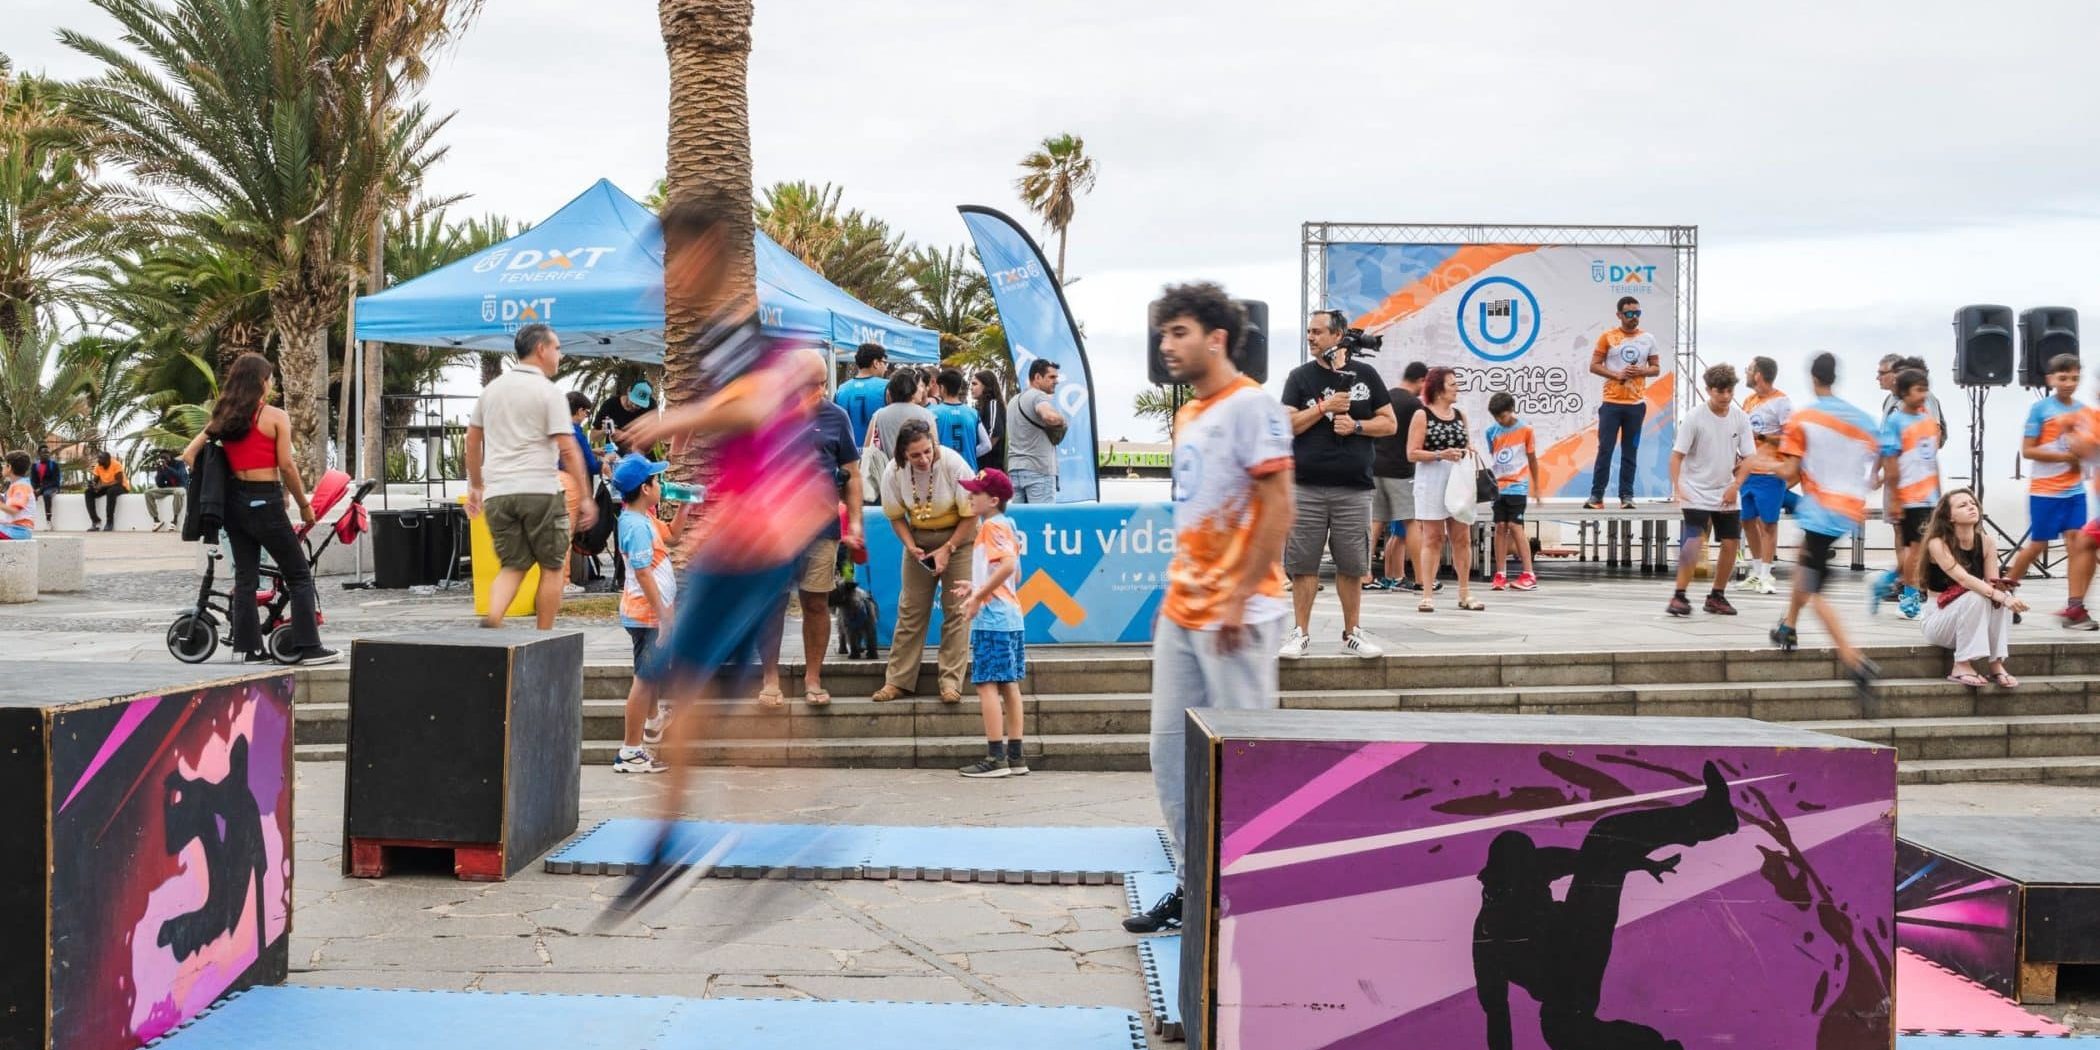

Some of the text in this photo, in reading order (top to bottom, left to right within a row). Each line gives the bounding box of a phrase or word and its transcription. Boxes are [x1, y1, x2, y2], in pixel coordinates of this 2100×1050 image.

[506, 247, 616, 270] DXT
[500, 270, 588, 283] TENERIFE
[1609, 265, 1656, 283] DXT
[1609, 284, 1653, 294] TENERIFE
[502, 298, 557, 321] DXT
[1454, 366, 1568, 392] enerife
[1513, 392, 1583, 414] rbano
[1042, 522, 1083, 555] tu
[1096, 519, 1178, 554] vida
